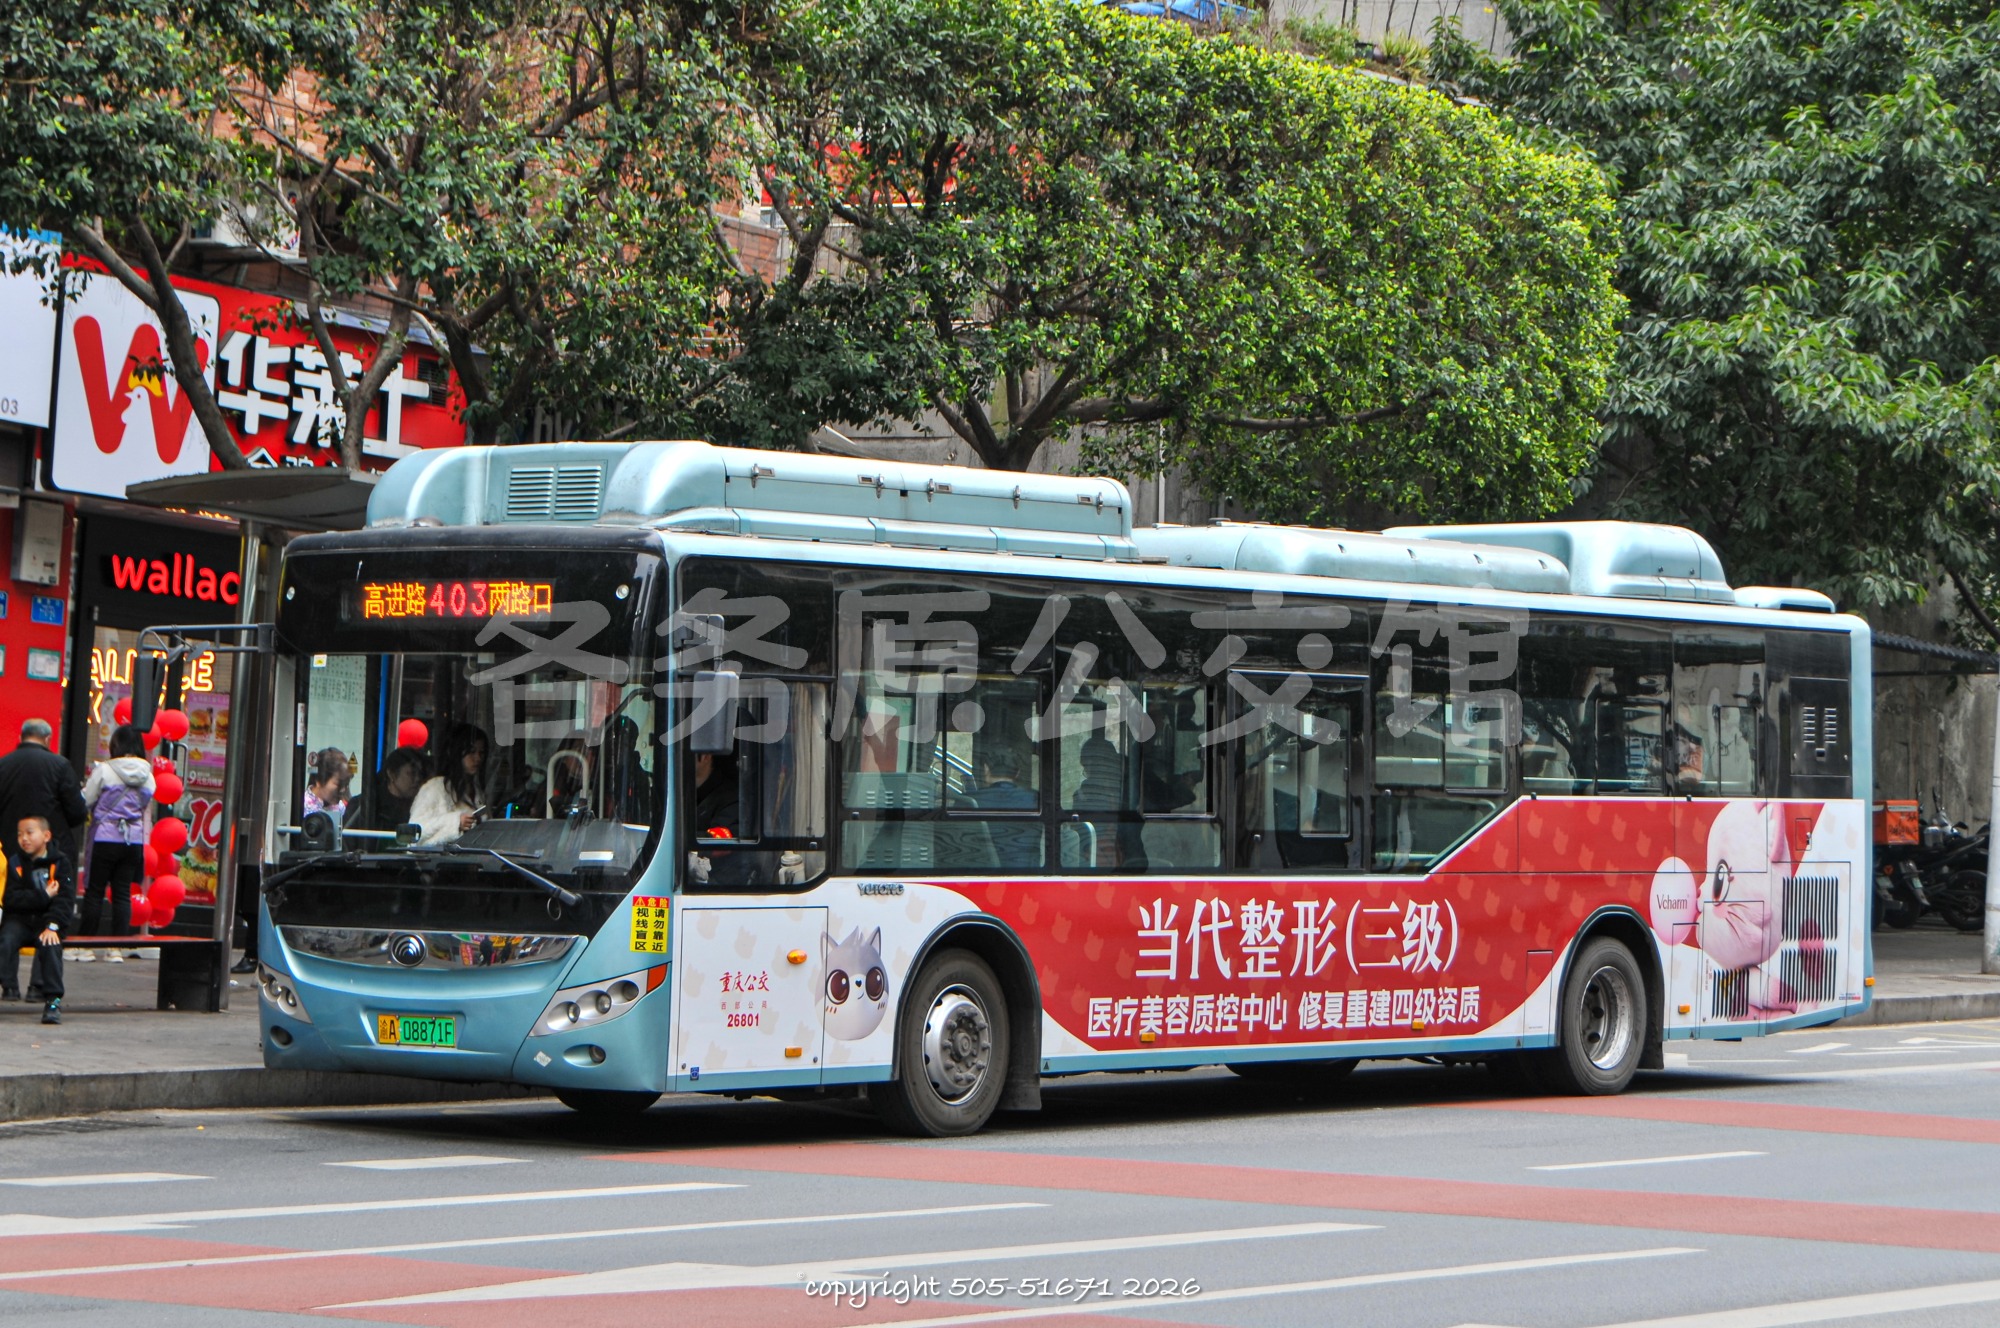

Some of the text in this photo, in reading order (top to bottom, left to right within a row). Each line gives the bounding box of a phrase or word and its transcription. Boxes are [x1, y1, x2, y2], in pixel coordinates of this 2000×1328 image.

[1656, 894, 1688, 910] Vcharm
[719, 971, 769, 992] 重庆公交
[727, 1012, 760, 1028] 26801
[1087, 985, 1480, 1037] 医疗美容质控中心 修复重建四级资质
